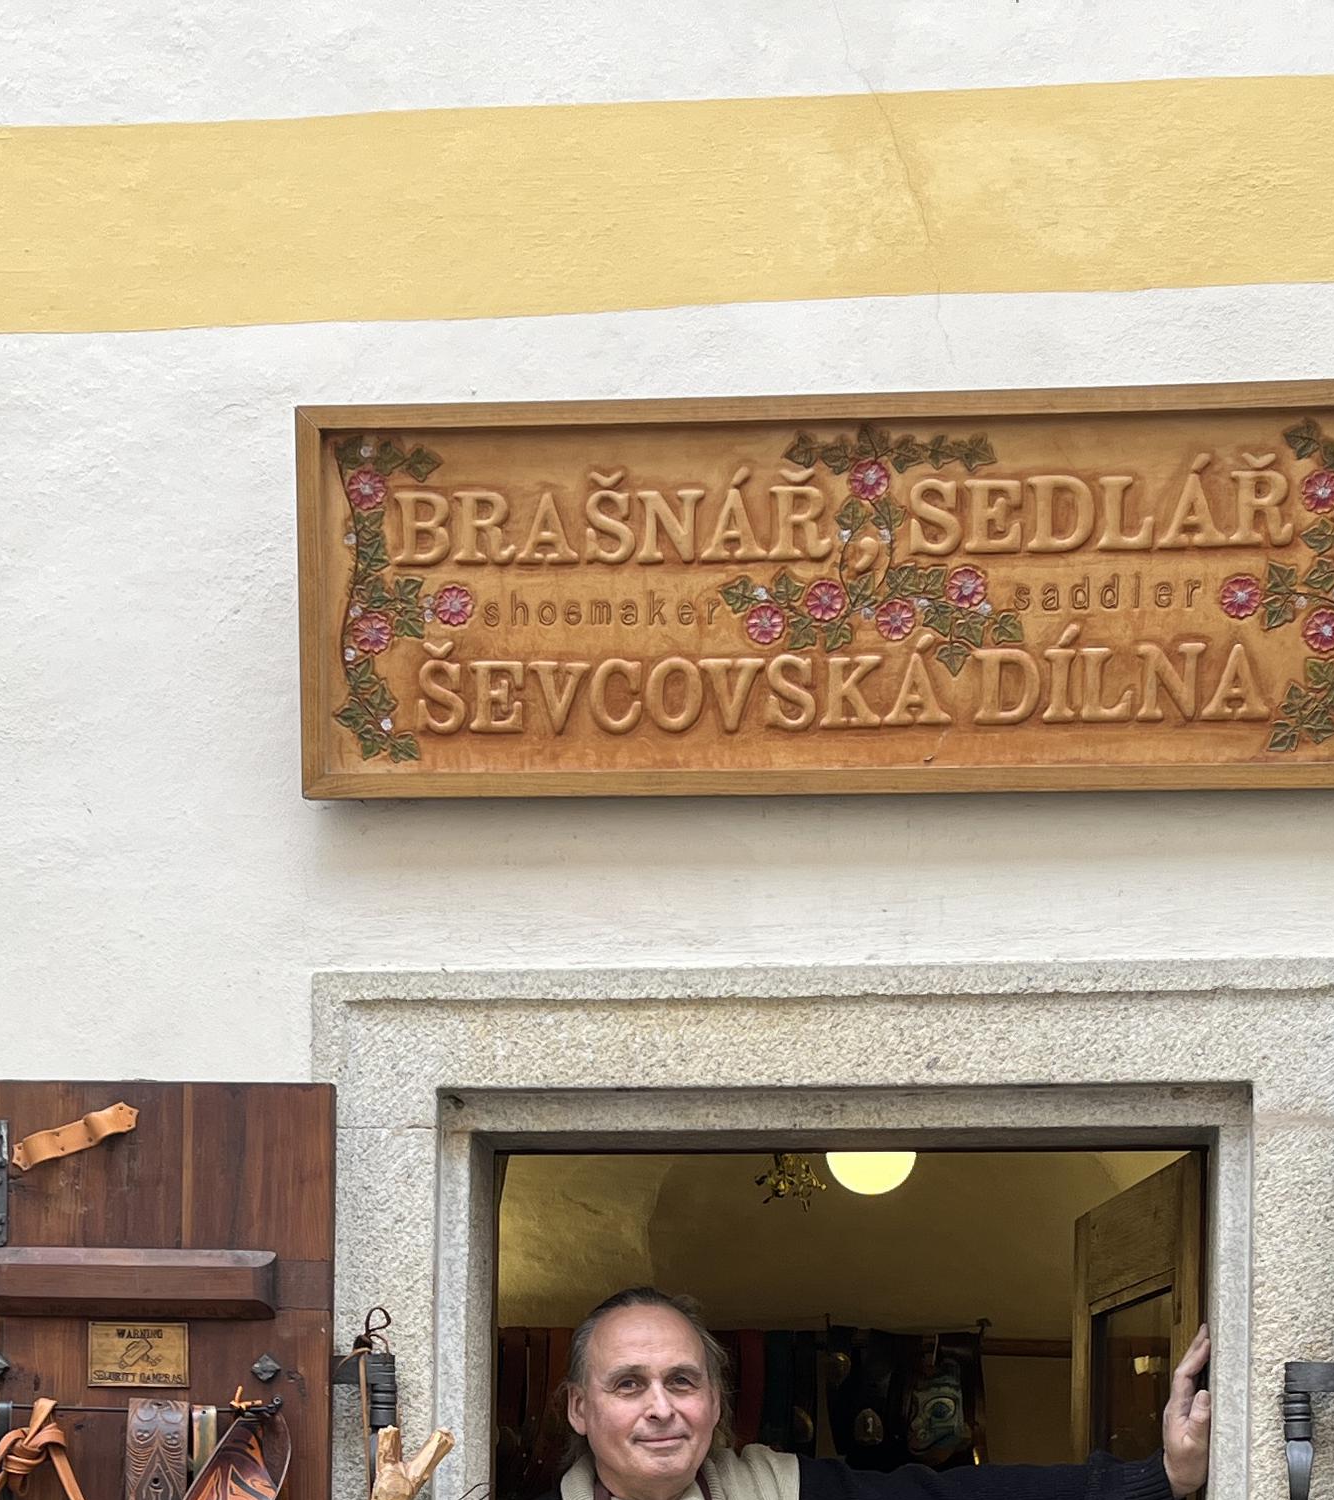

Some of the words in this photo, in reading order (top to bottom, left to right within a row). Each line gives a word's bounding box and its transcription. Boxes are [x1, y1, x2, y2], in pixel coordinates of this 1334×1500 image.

[909, 452, 1294, 556] SEDLÁŘ
[483, 590, 722, 627] shoemaker
[1013, 572, 1201, 612] saddler
[417, 633, 953, 735] ŠEVCOVSKÁ
[972, 623, 1269, 726] DÍLNA
[116, 1328, 163, 1339] WARNING
